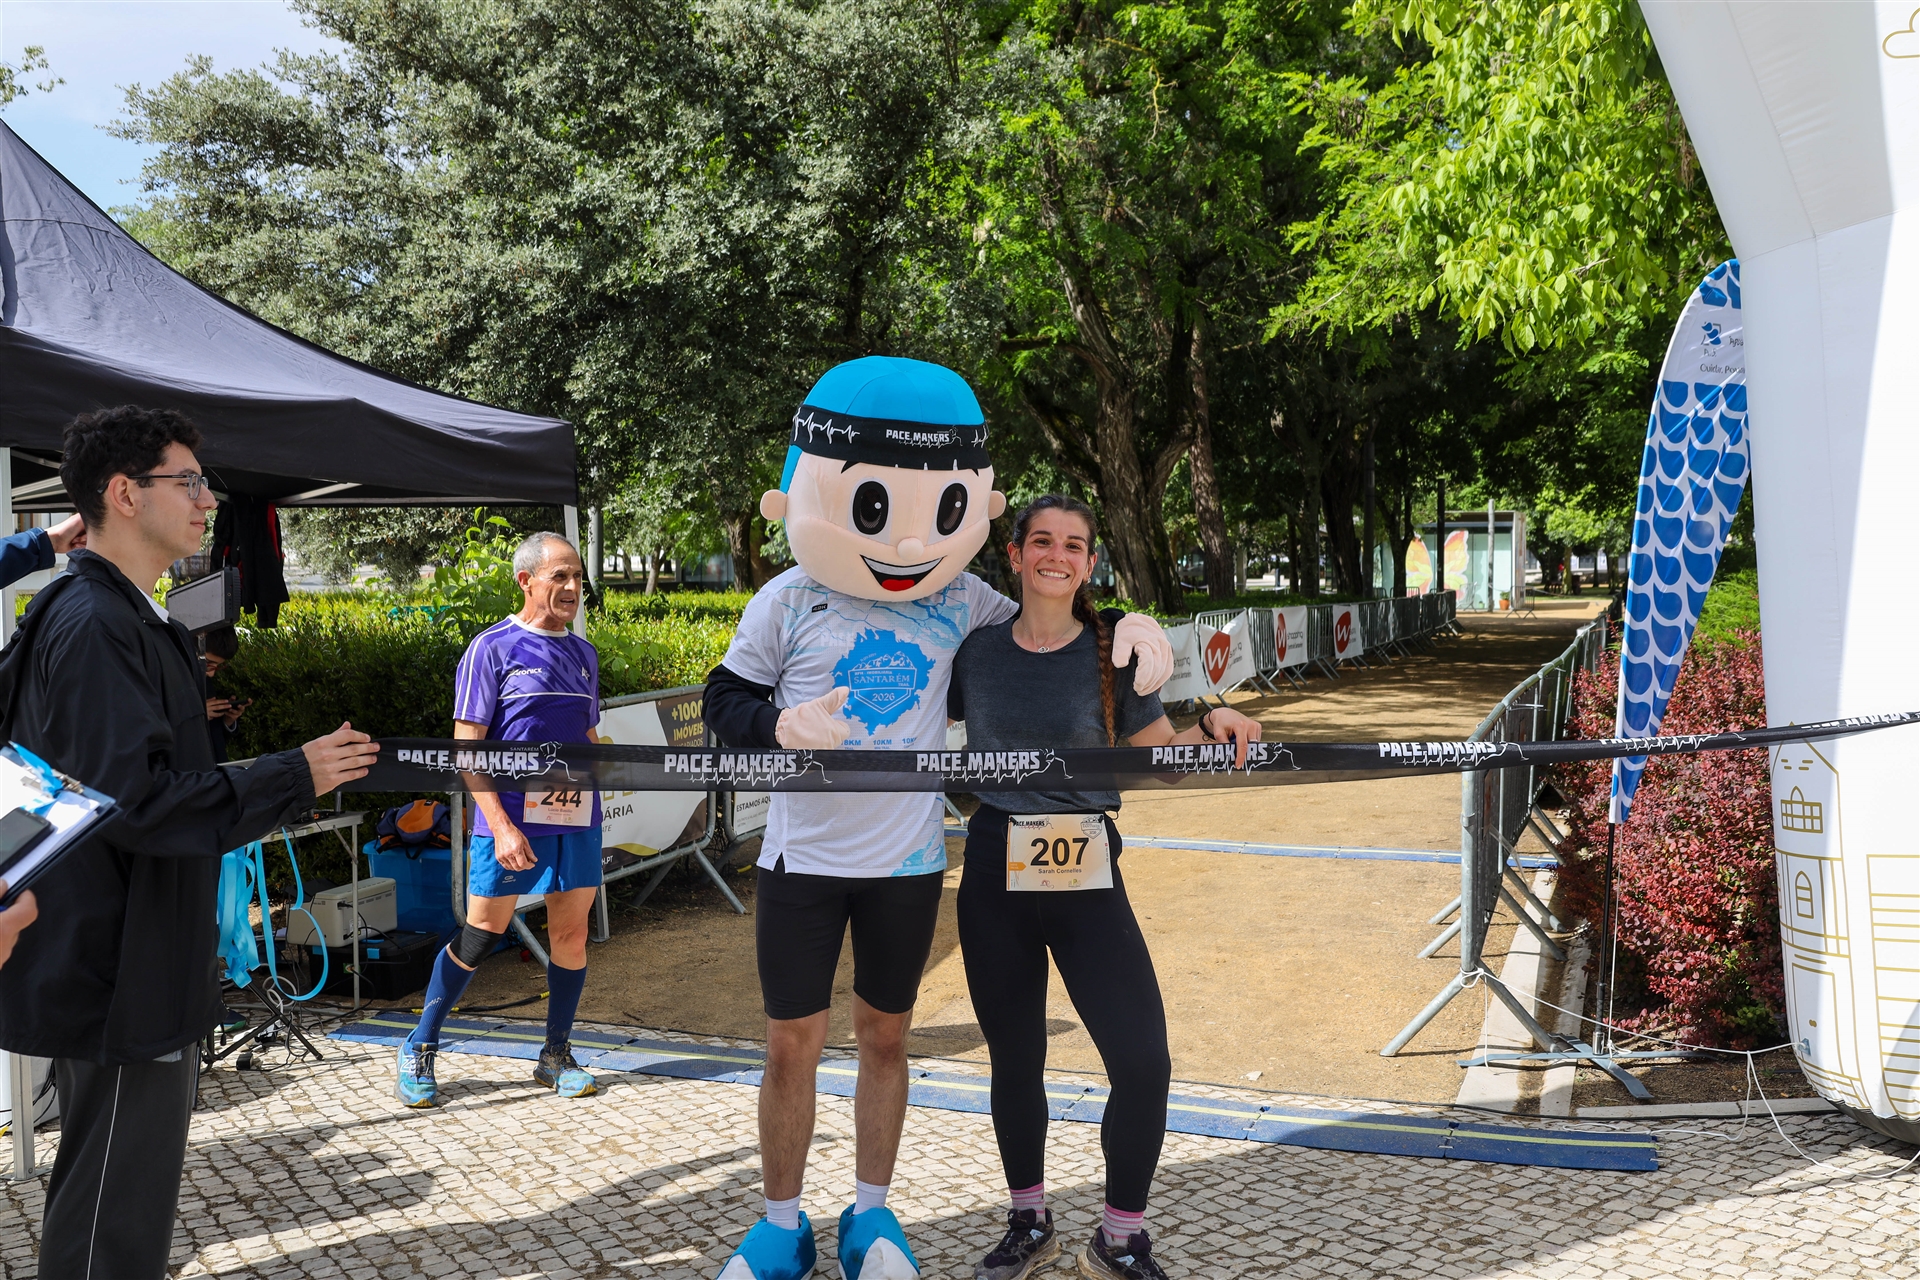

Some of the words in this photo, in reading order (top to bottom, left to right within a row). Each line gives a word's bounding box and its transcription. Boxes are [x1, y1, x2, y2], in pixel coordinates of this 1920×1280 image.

[853, 672, 910, 684] SANTARÉM
[872, 692, 895, 702] 2026
[673, 722, 704, 741] IMÓVEIS
[540, 785, 582, 808] 244
[736, 798, 761, 812] ESTAMOS
[1030, 837, 1090, 867] 207
